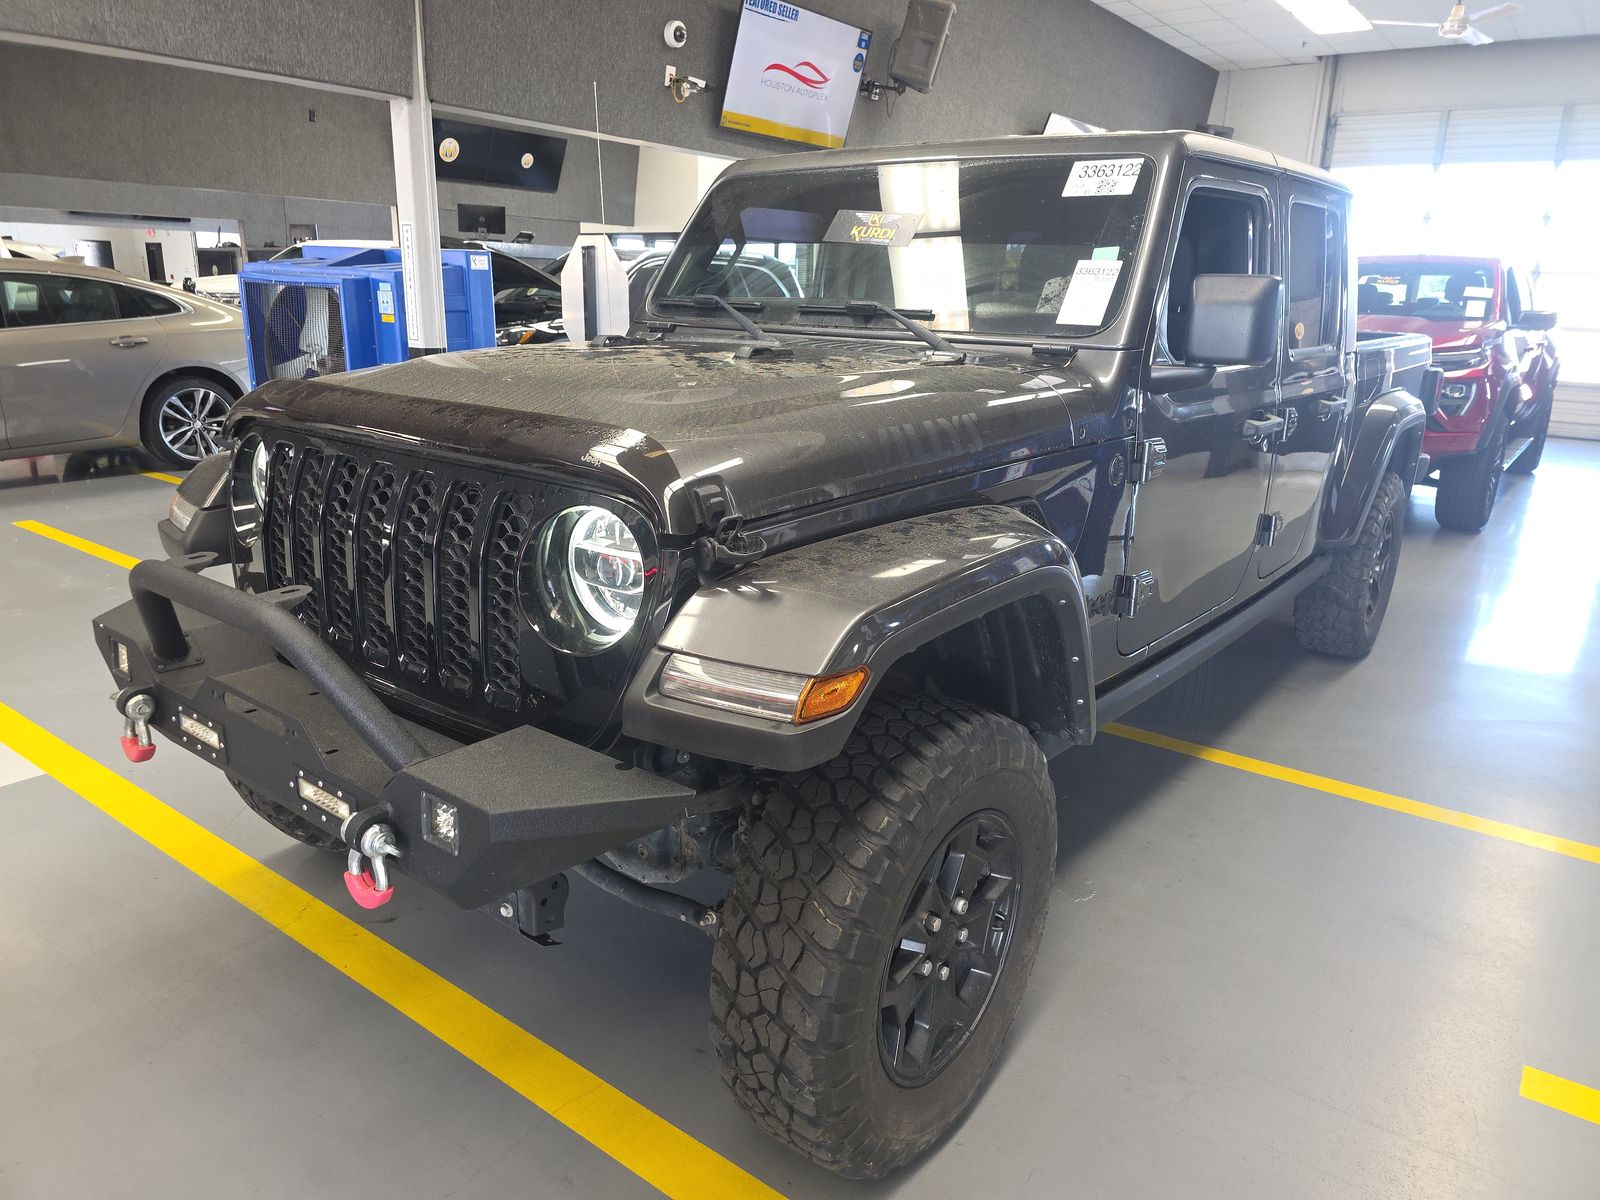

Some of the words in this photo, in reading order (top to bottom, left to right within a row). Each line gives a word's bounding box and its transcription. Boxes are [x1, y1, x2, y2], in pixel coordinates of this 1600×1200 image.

[778, 4, 799, 21] SELLER
[760, 79, 795, 93] HOUSTON
[1078, 163, 1143, 179] 3363122
[850, 225, 896, 242] KURDI
[1076, 267, 1119, 276] 3363122
[580, 452, 602, 468] Jeep
[1085, 590, 1116, 617] eep
